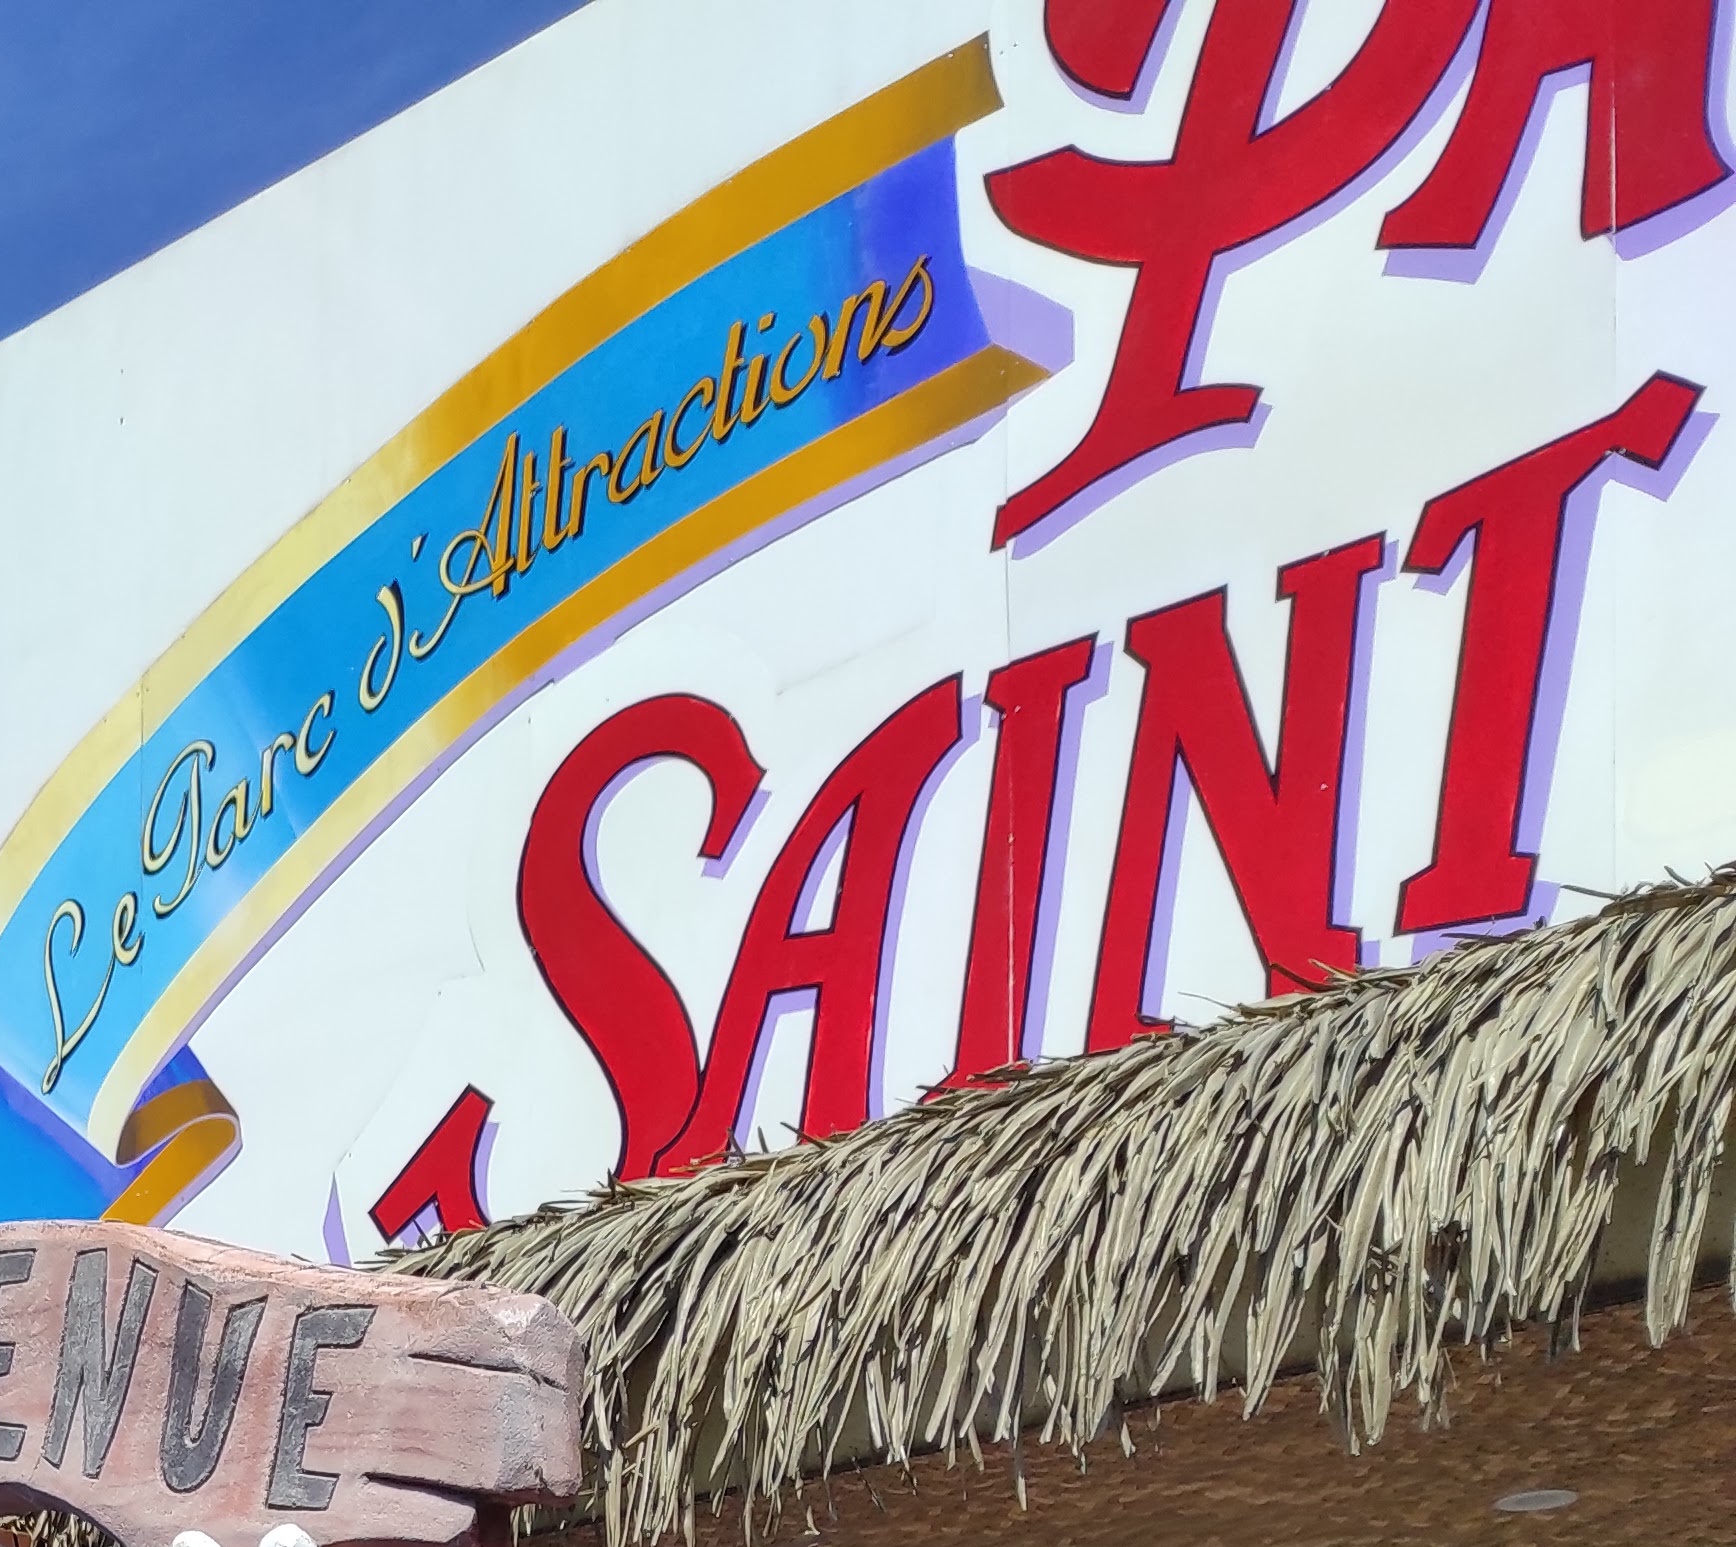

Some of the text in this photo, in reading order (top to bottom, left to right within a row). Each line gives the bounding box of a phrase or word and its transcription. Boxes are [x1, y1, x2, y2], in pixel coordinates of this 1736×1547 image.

[40, 255, 936, 1097] Le Parc d'Attractions
[517, 368, 1704, 1179] SAINT
